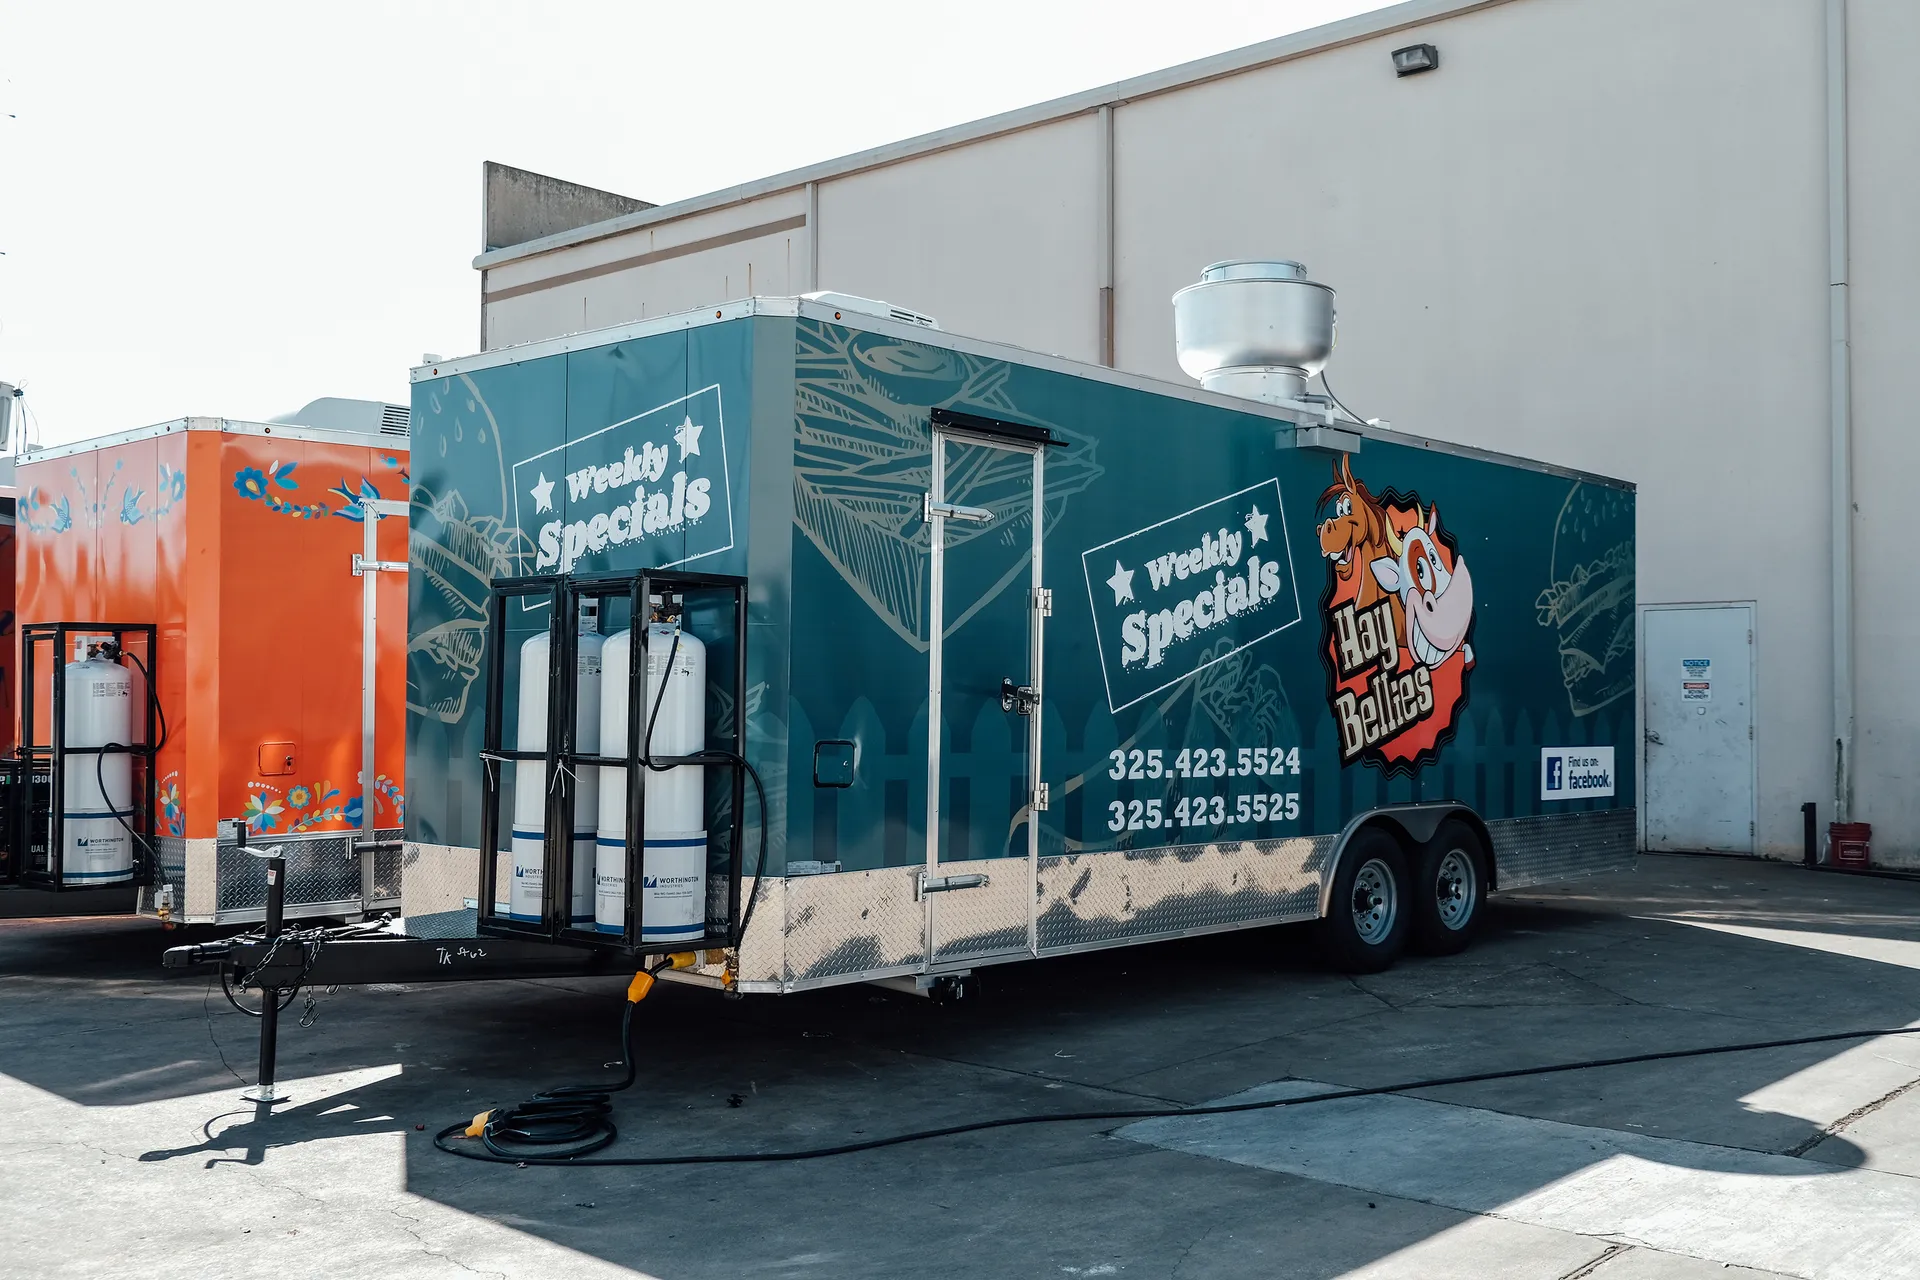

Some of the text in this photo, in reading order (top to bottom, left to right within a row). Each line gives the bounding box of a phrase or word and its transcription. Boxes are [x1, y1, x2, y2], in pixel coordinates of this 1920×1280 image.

[565, 441, 669, 503] Weekly
[536, 471, 711, 574] Specials
[1144, 528, 1242, 591] Weekly
[1121, 555, 1280, 670] Specials
[1333, 601, 1399, 672] Hay
[1335, 665, 1434, 759] Bellies
[1108, 747, 1300, 781] 325.423.5524
[1568, 756, 1581, 767] Find
[1582, 758, 1589, 767] us
[1107, 792, 1299, 832] 325.423.5525
[31, 845, 45, 853] UAL
[659, 876, 699, 884] WORTHINGTON
[436, 947, 452, 964] TK
